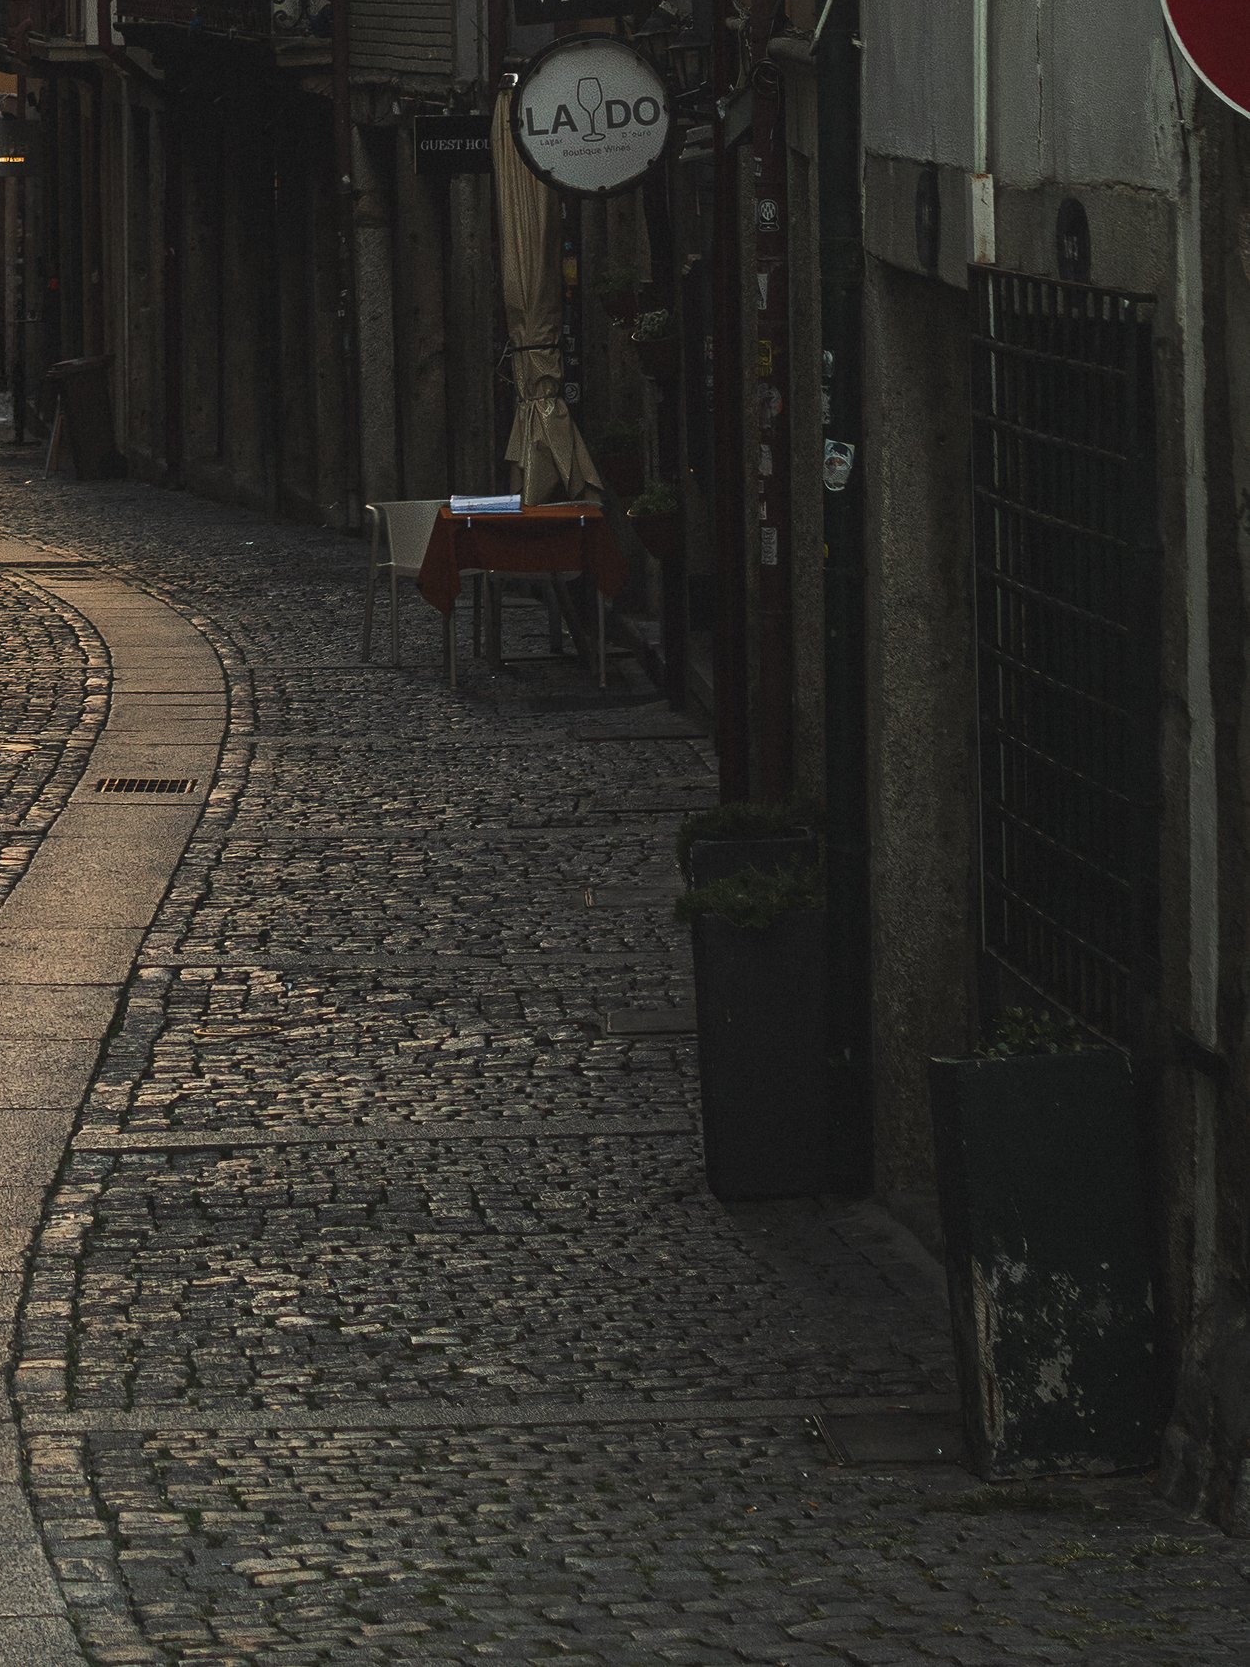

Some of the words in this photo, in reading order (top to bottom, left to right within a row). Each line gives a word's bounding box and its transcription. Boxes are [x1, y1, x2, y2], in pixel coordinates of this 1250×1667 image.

[420, 139, 463, 151] GUEST
[539, 138, 564, 148] Lagar
[562, 148, 602, 159] Boutique
